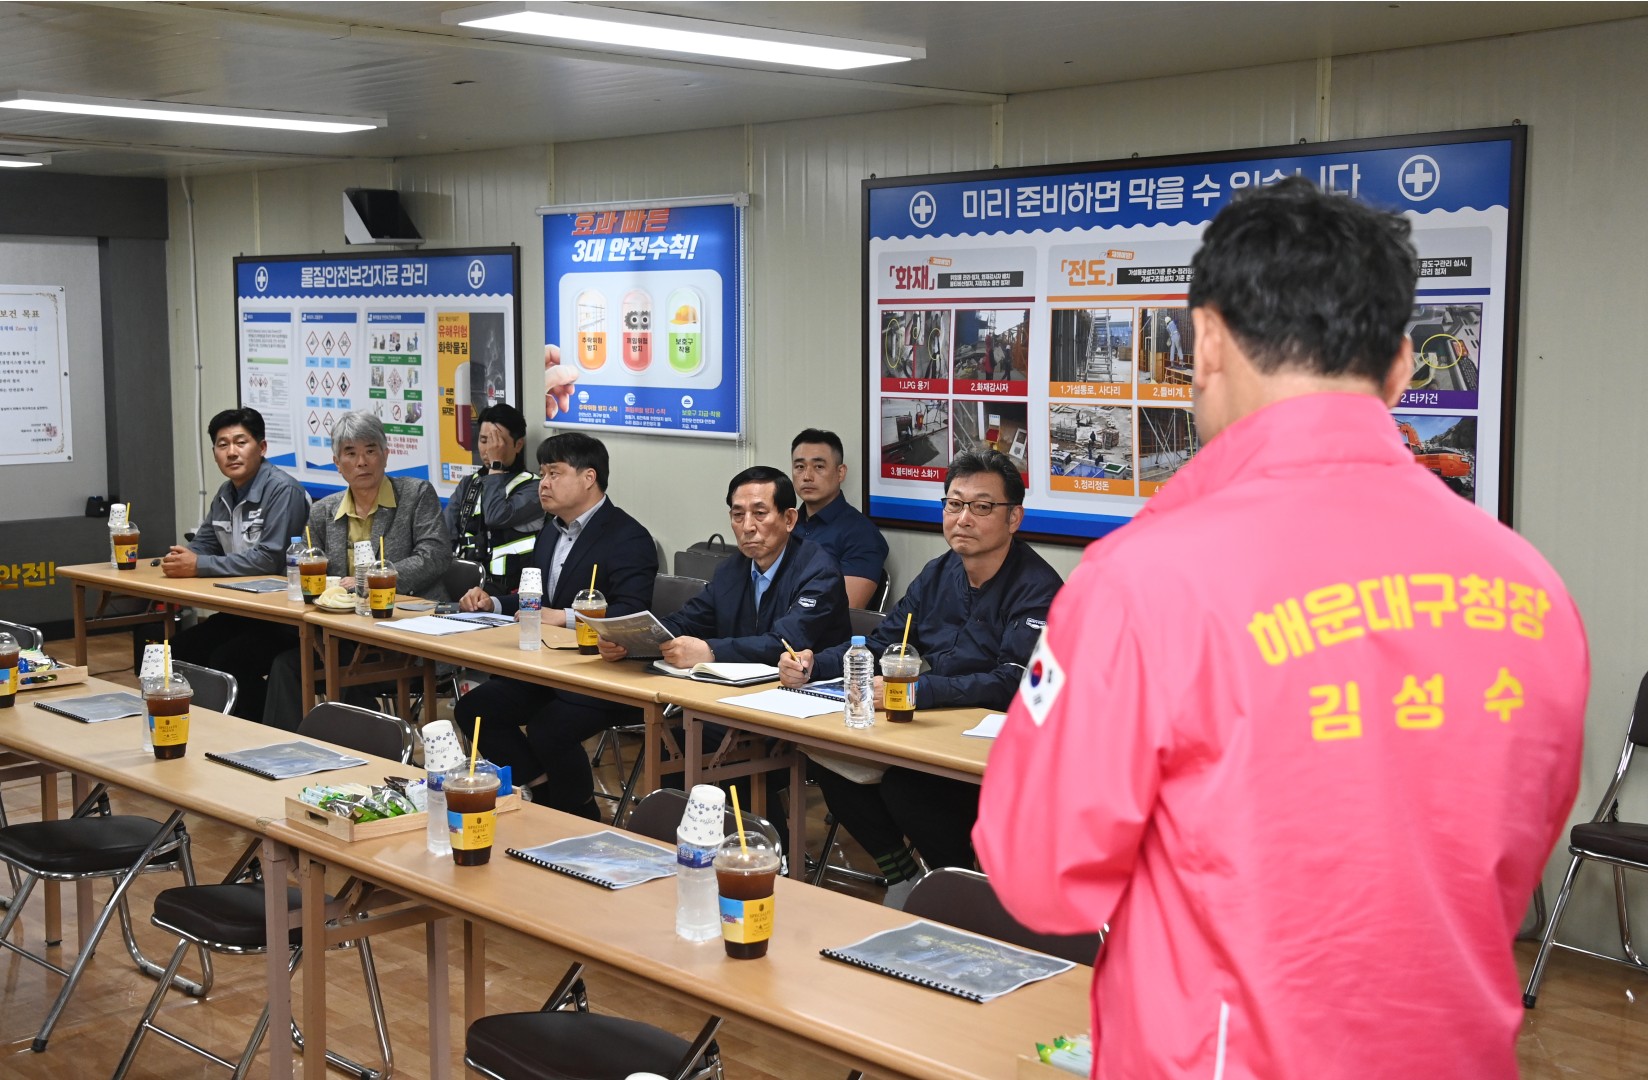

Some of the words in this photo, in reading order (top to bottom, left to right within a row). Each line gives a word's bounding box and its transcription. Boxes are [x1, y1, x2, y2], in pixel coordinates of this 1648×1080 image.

[962, 187, 1010, 220] 미리
[1016, 180, 1120, 218] 준비하면
[1128, 175, 1184, 211] 막을
[1192, 174, 1221, 207] 수
[571, 211, 618, 236] 효과
[621, 208, 670, 234] 빠른
[571, 238, 606, 263] 3대
[608, 233, 699, 262] 안전수칙!
[301, 265, 398, 288] 물질안전보건자료
[401, 263, 428, 286] 관리
[22, 309, 40, 318] 목표
[438, 324, 468, 338] 유해위험
[438, 342, 468, 354] 화학물질
[678, 346, 691, 354] 착용
[899, 381, 916, 390] 1.LPG
[917, 380, 930, 390] 용기
[970, 382, 1008, 392] 2.화재감시자
[1060, 384, 1096, 396] 1.가설통로,
[1098, 385, 1121, 396] 사다리
[1400, 392, 1438, 404] 2.타카건
[890, 466, 920, 478] 3.불티비산
[920, 468, 940, 479] 소화기
[1074, 479, 1110, 491] 3.정리정돈
[0, 561, 55, 589] 안전!
[1247, 572, 1551, 666] 해운대구청장
[1308, 680, 1363, 742] 김
[1391, 672, 1445, 730] 성
[1483, 666, 1525, 723] 수
